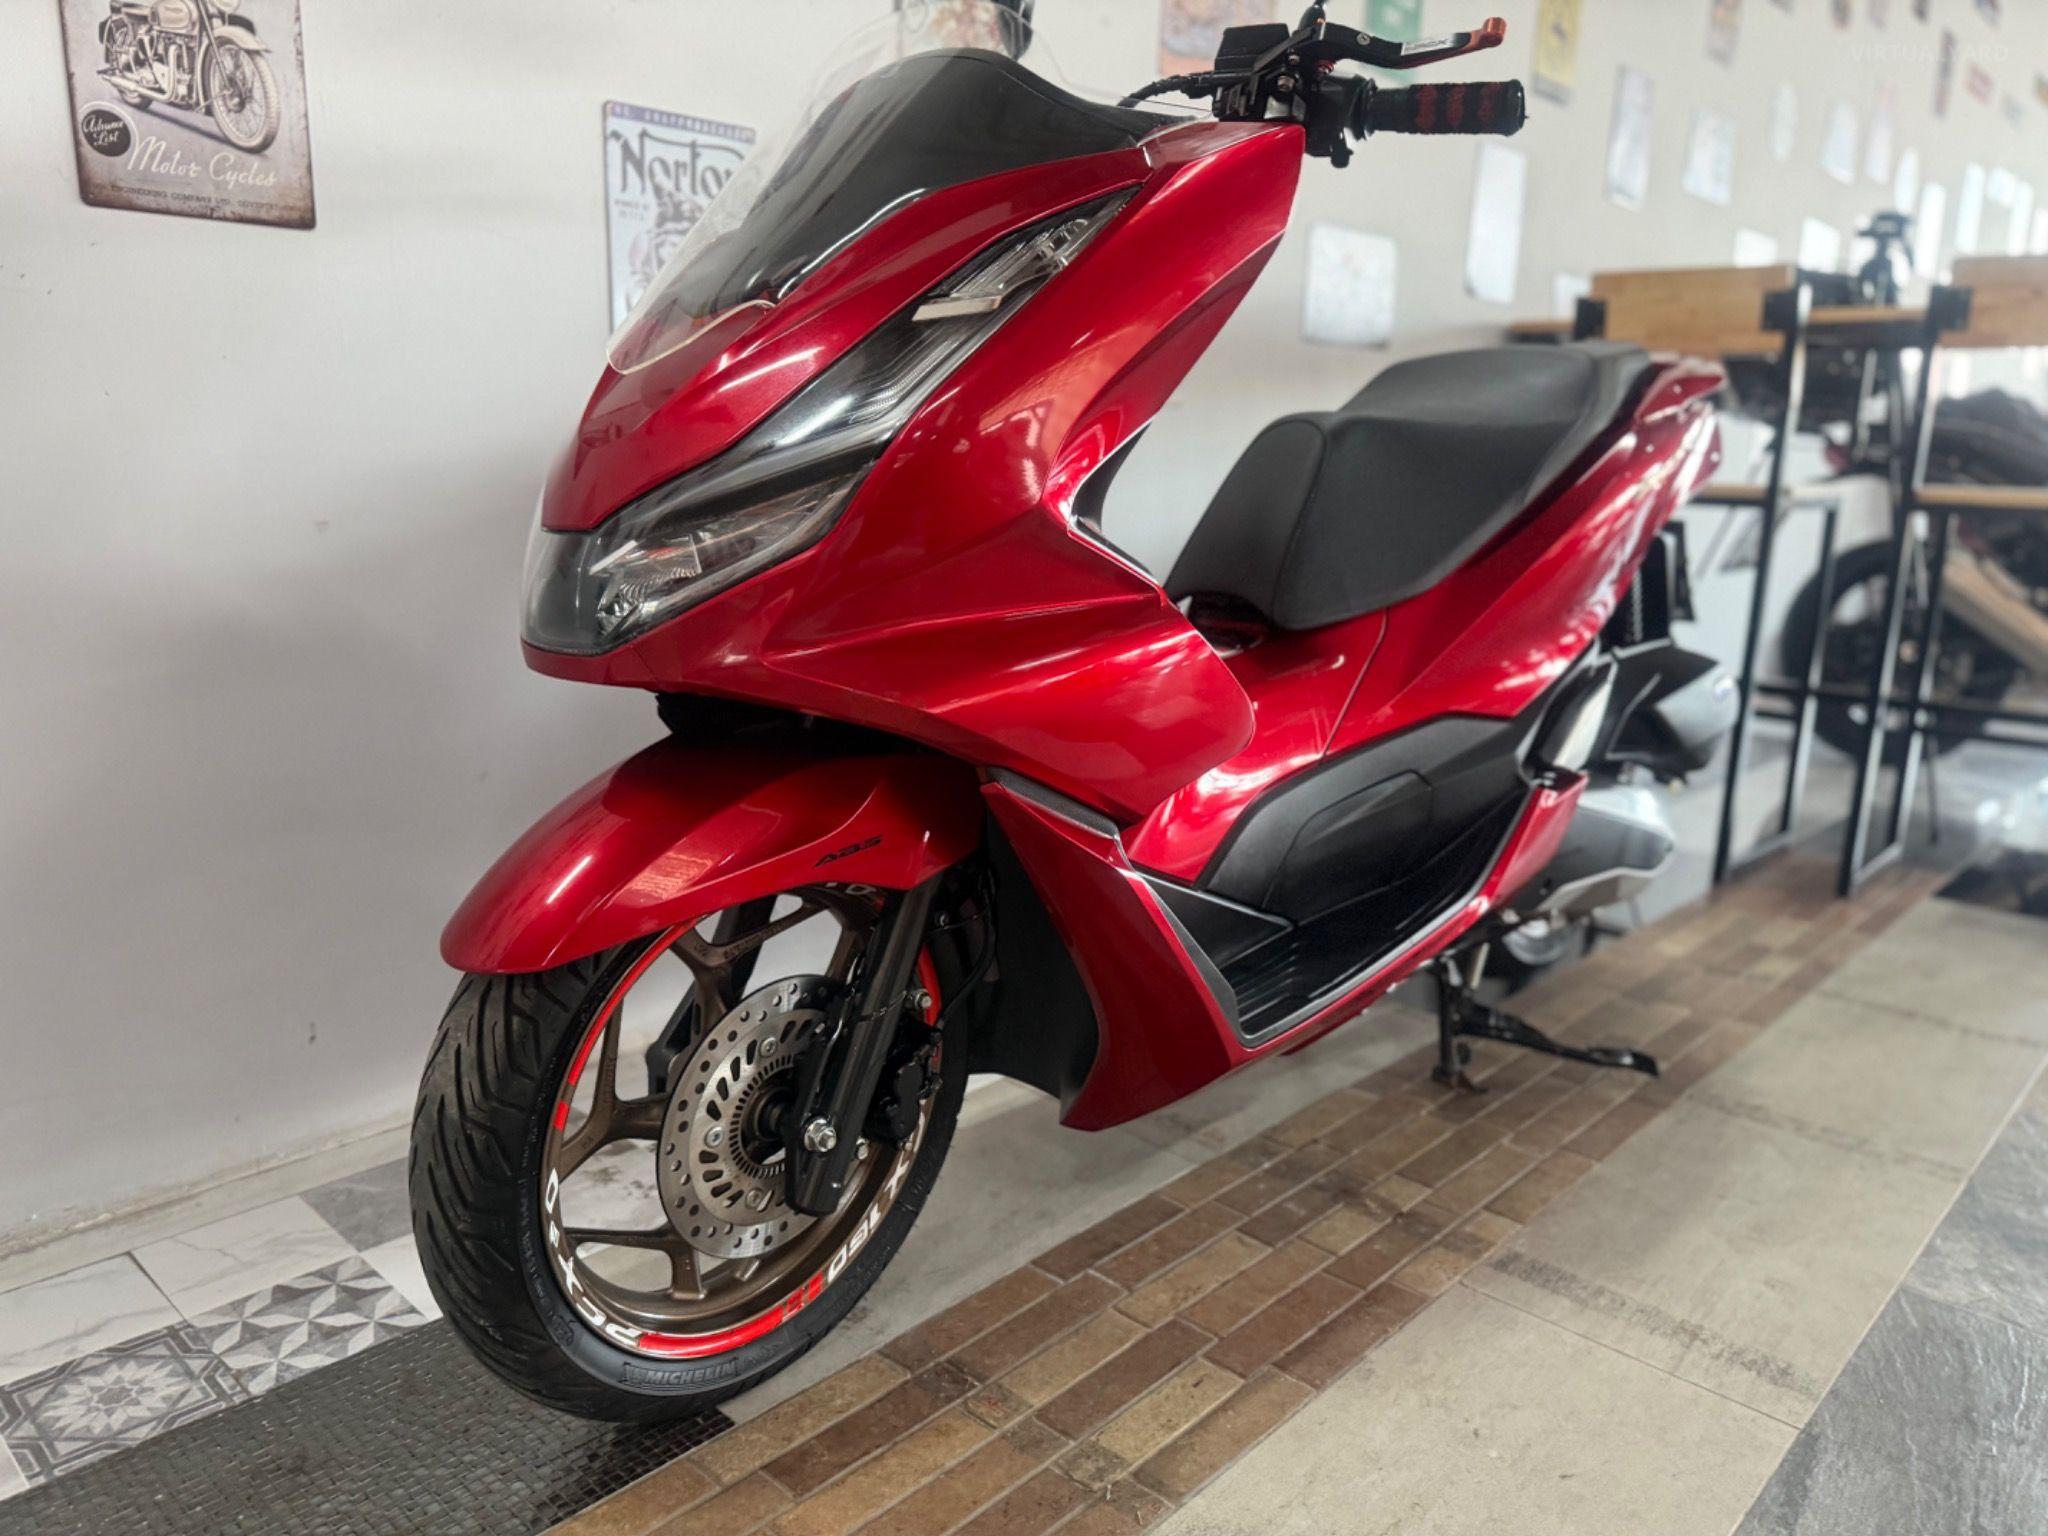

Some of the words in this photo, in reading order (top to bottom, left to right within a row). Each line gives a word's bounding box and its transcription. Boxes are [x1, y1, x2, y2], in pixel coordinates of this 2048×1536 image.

[127, 136, 201, 178] Motor
[209, 153, 278, 190] Cycles
[608, 128, 740, 199] Norto
[813, 835, 883, 868] ABS
[559, 1254, 642, 1348] PCX
[645, 1360, 738, 1385] MICHELIN
